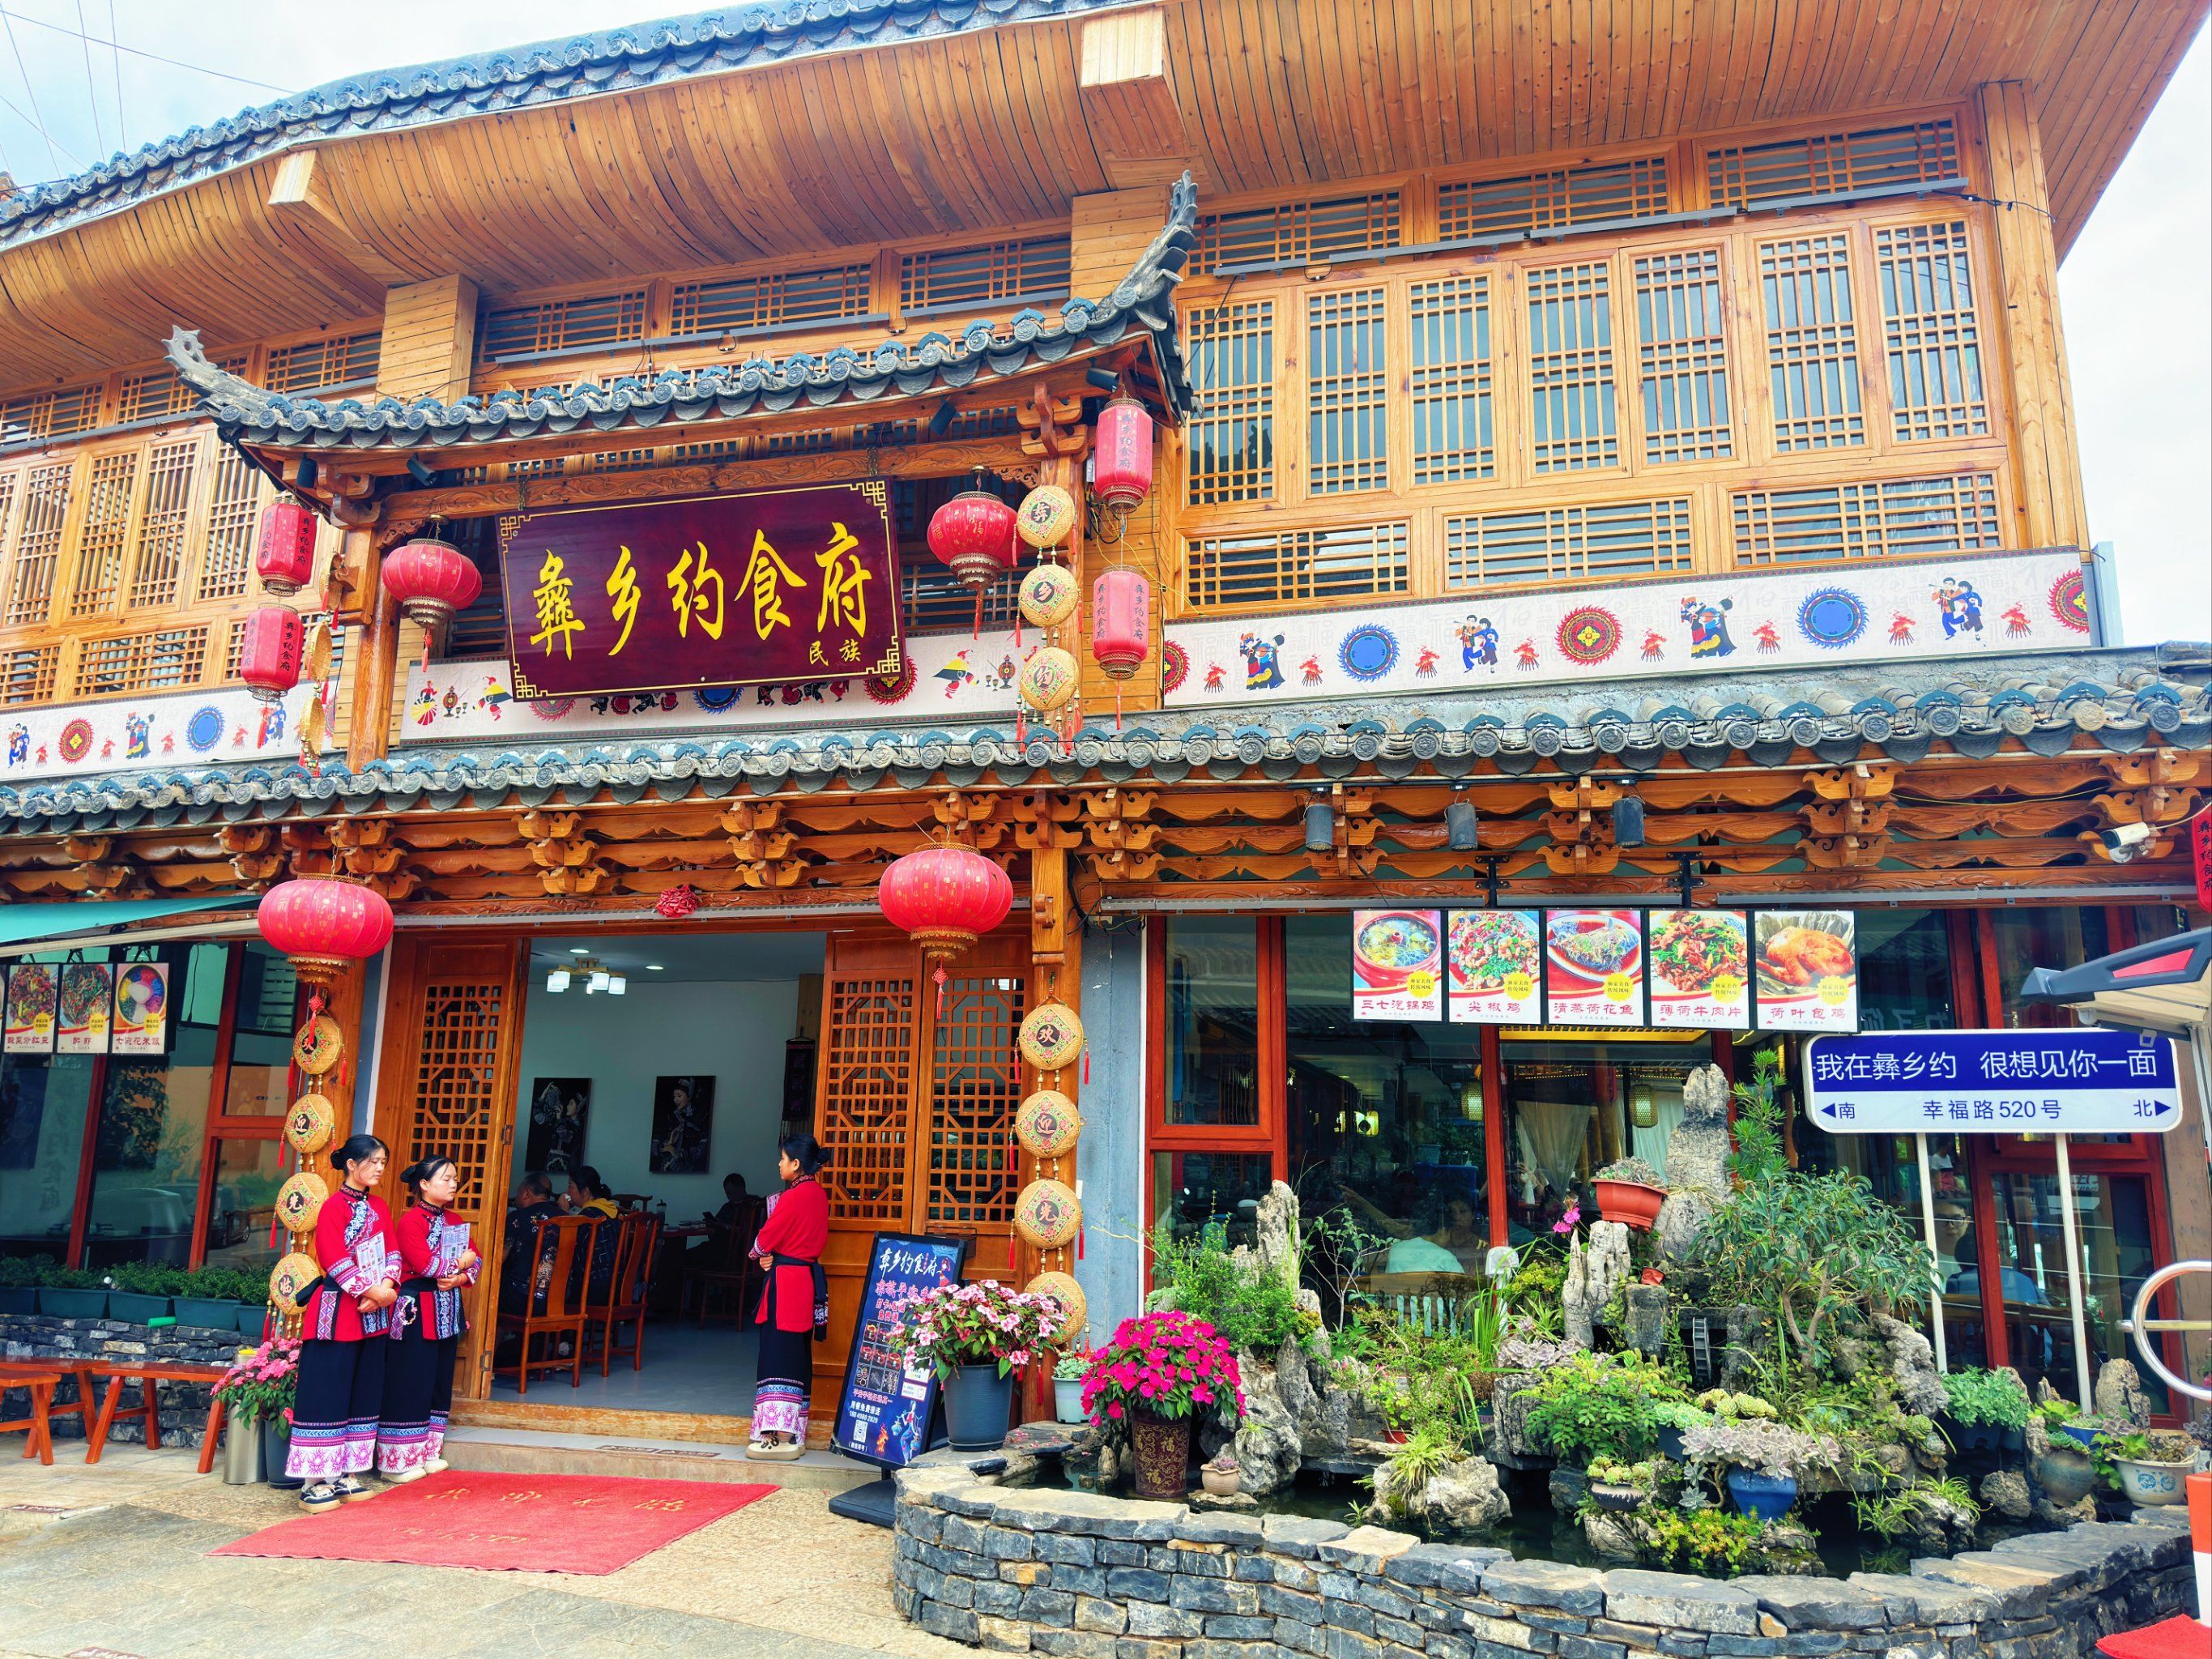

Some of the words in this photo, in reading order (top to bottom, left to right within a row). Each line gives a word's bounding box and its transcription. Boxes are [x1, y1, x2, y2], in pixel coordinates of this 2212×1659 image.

[530, 521, 873, 661] 彝乡约食府
[809, 639, 861, 667] 民族
[1361, 1000, 1435, 1011] 三七汽锅鸡
[1468, 1002, 1521, 1013] 尖椒鸡
[1554, 1002, 1634, 1016] 清蒸荷花鱼
[1660, 1004, 1742, 1017] 薄荷牛肉片
[1771, 1007, 1847, 1020] 荷叶包鸡
[1816, 1052, 1957, 1081] 我在彝乡约
[1980, 1049, 2158, 1080] 很想见你一面
[1839, 1102, 1856, 1120] 南
[1923, 1098, 2062, 1120] 幸福路520号
[2133, 1099, 2154, 1118] 北
